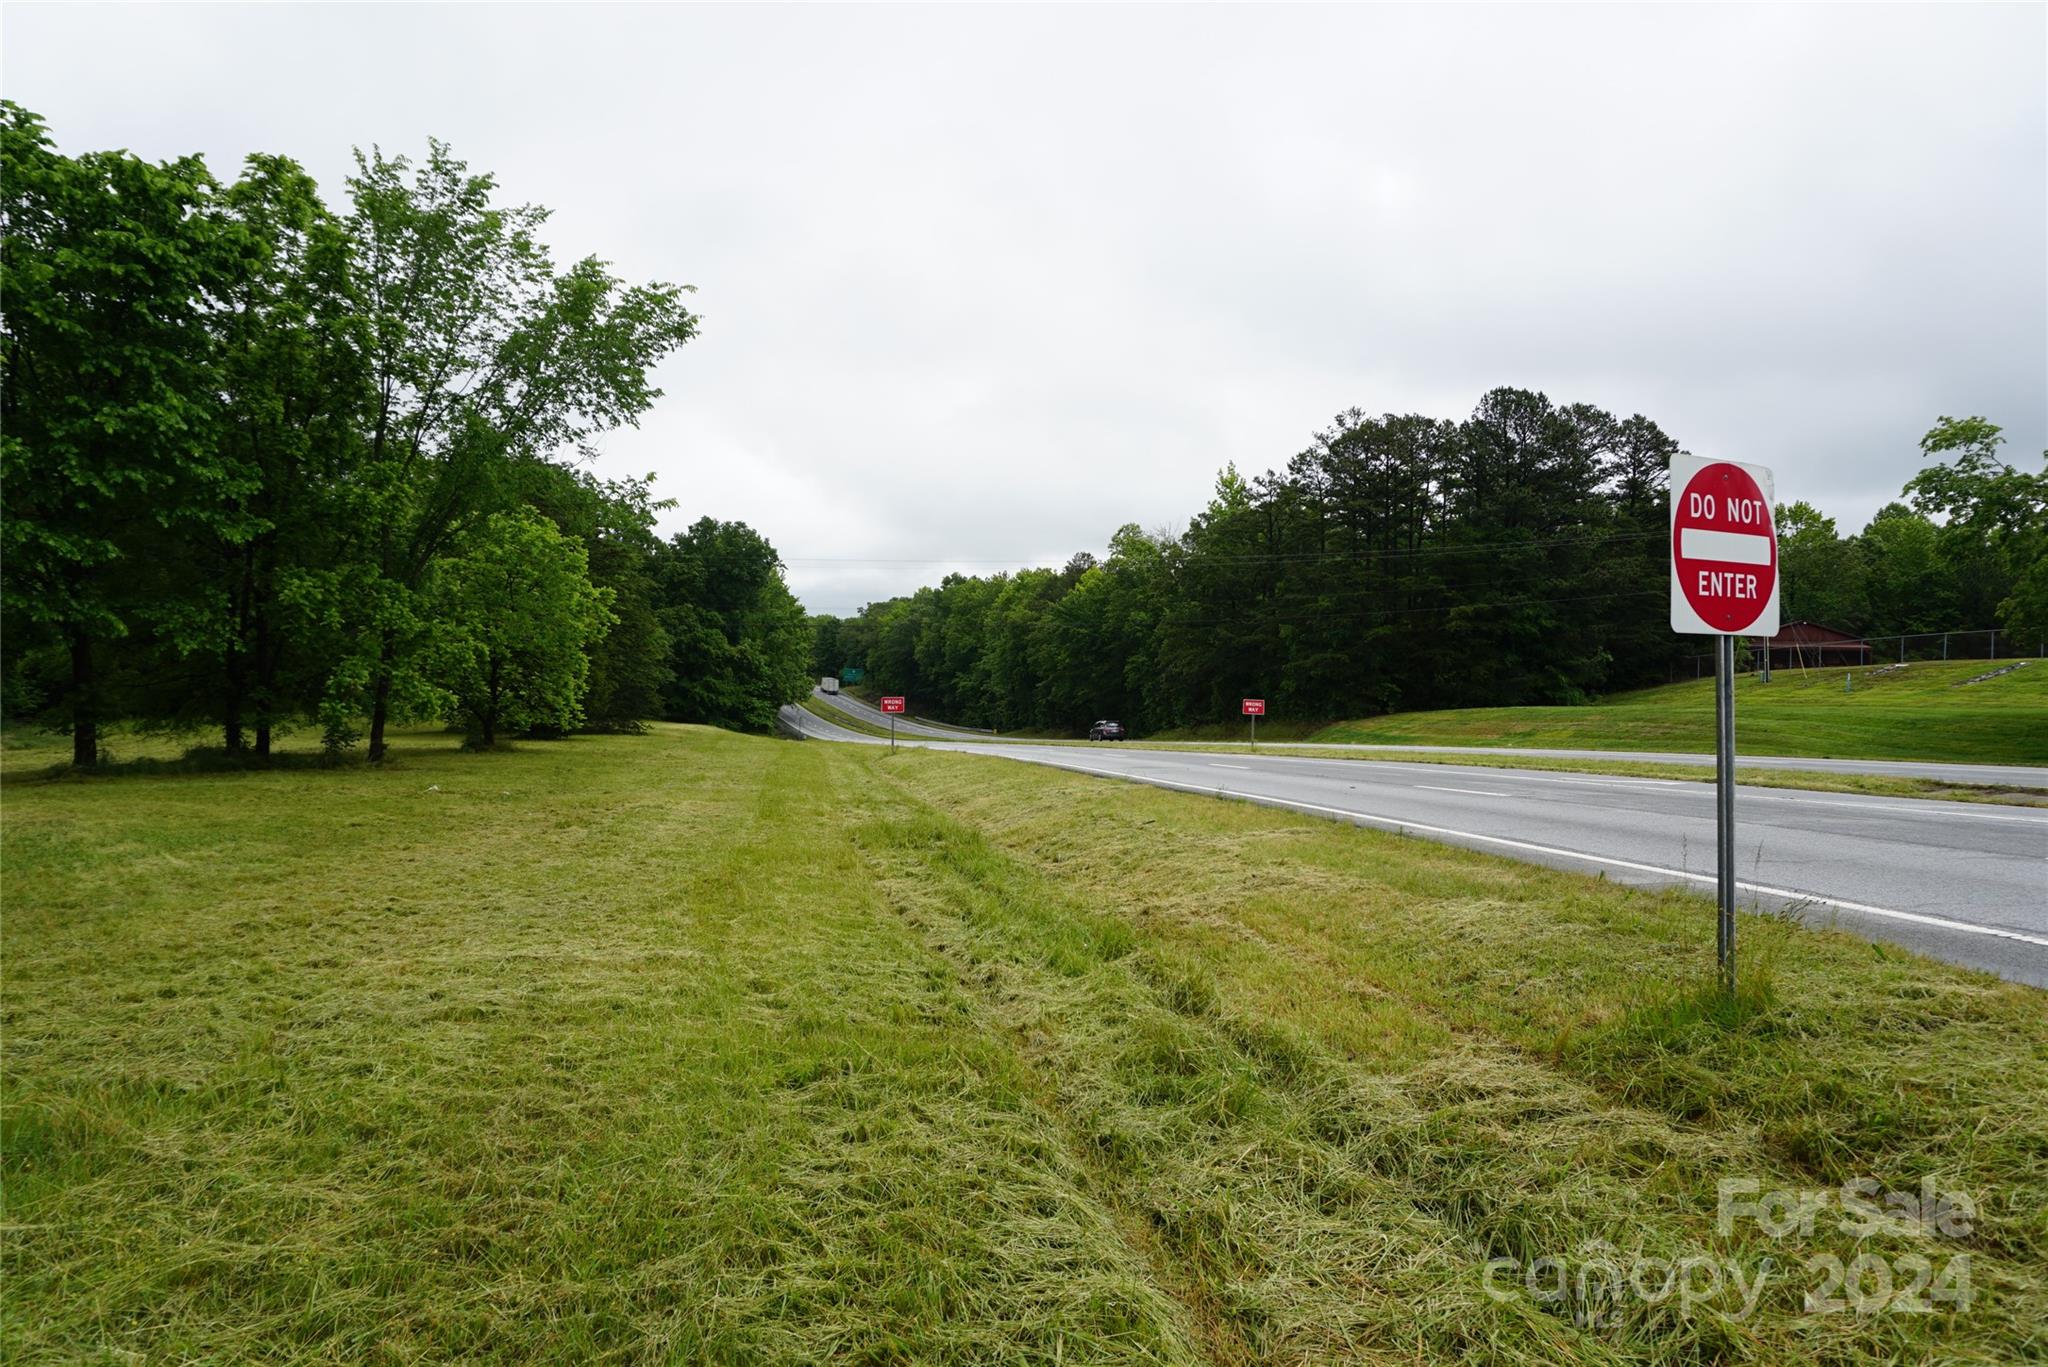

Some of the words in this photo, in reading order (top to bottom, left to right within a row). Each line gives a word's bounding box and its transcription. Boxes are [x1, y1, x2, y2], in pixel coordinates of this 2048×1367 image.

[1690, 493, 1715, 519] DO
[1728, 498, 1761, 525] NOT
[1698, 571, 1757, 599] ENTER
